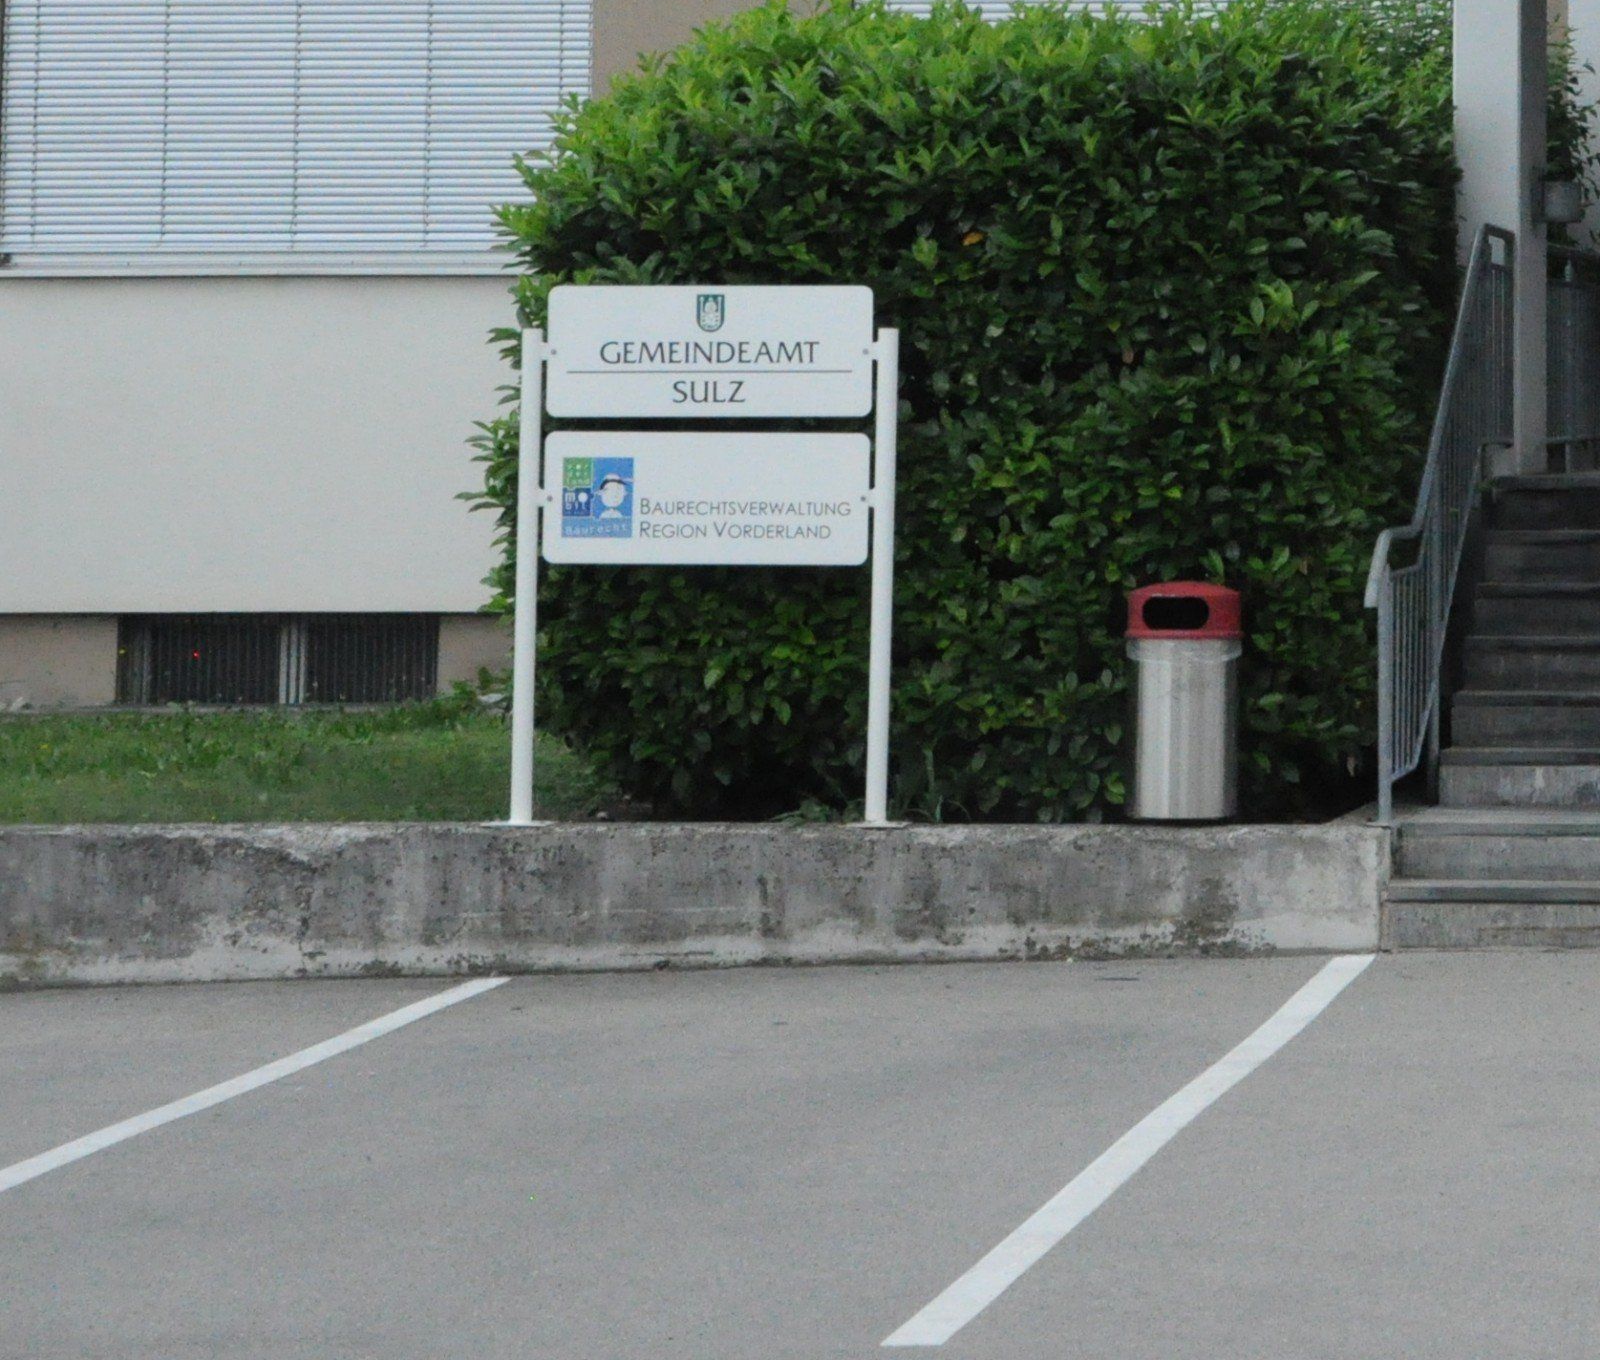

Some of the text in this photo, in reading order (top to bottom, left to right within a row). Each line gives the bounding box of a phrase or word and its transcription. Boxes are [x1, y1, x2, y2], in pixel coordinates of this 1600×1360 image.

[599, 341, 820, 364] GEMEINDEAMT
[672, 380, 747, 403] SULZ
[639, 522, 832, 539] REGION VORDERLAND
